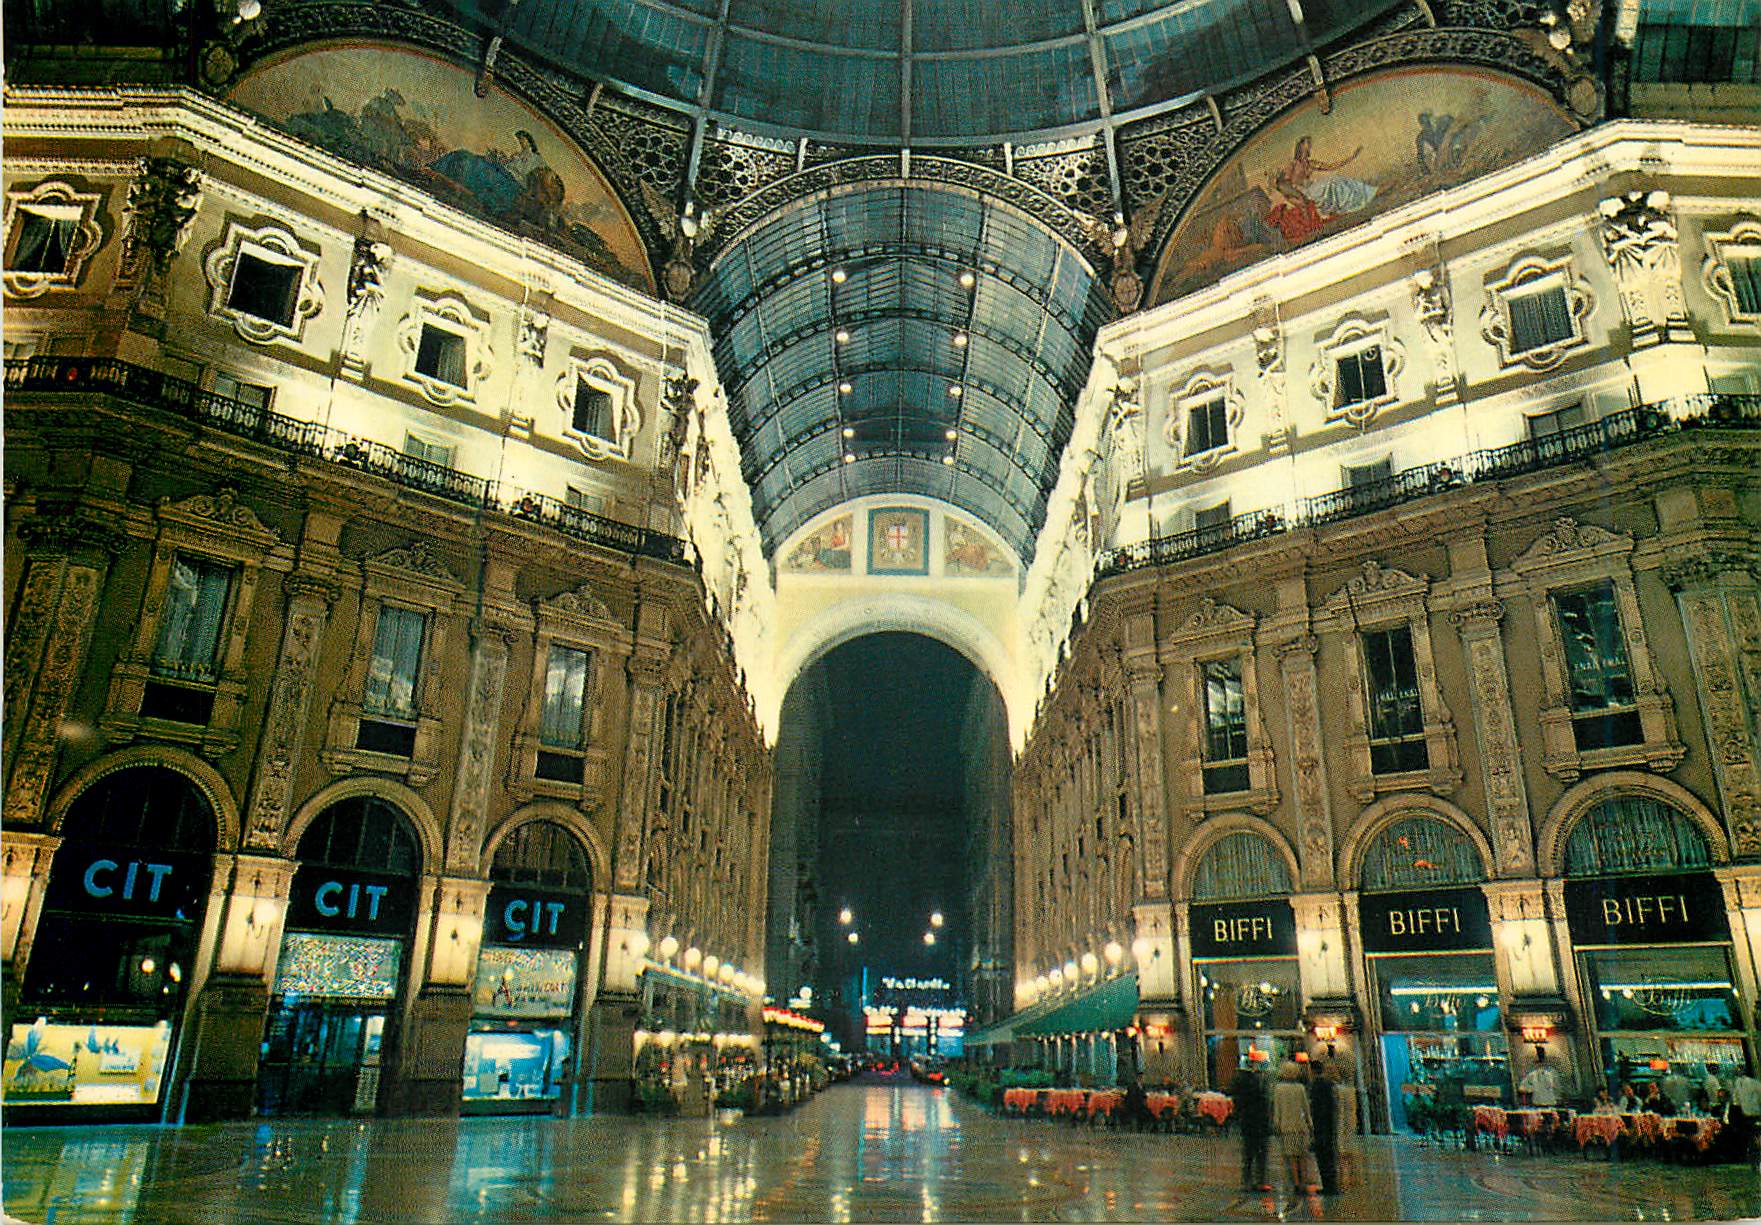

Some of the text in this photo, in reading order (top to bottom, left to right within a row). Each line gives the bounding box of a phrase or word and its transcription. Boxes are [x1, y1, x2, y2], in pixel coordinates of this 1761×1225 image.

[84, 859, 173, 902] CIT
[315, 881, 388, 921] CIT
[504, 899, 565, 935] CIT
[1602, 895, 1689, 925] BIFFI
[1214, 916, 1273, 942] BIFFI
[1389, 907, 1461, 935] BIFFI
